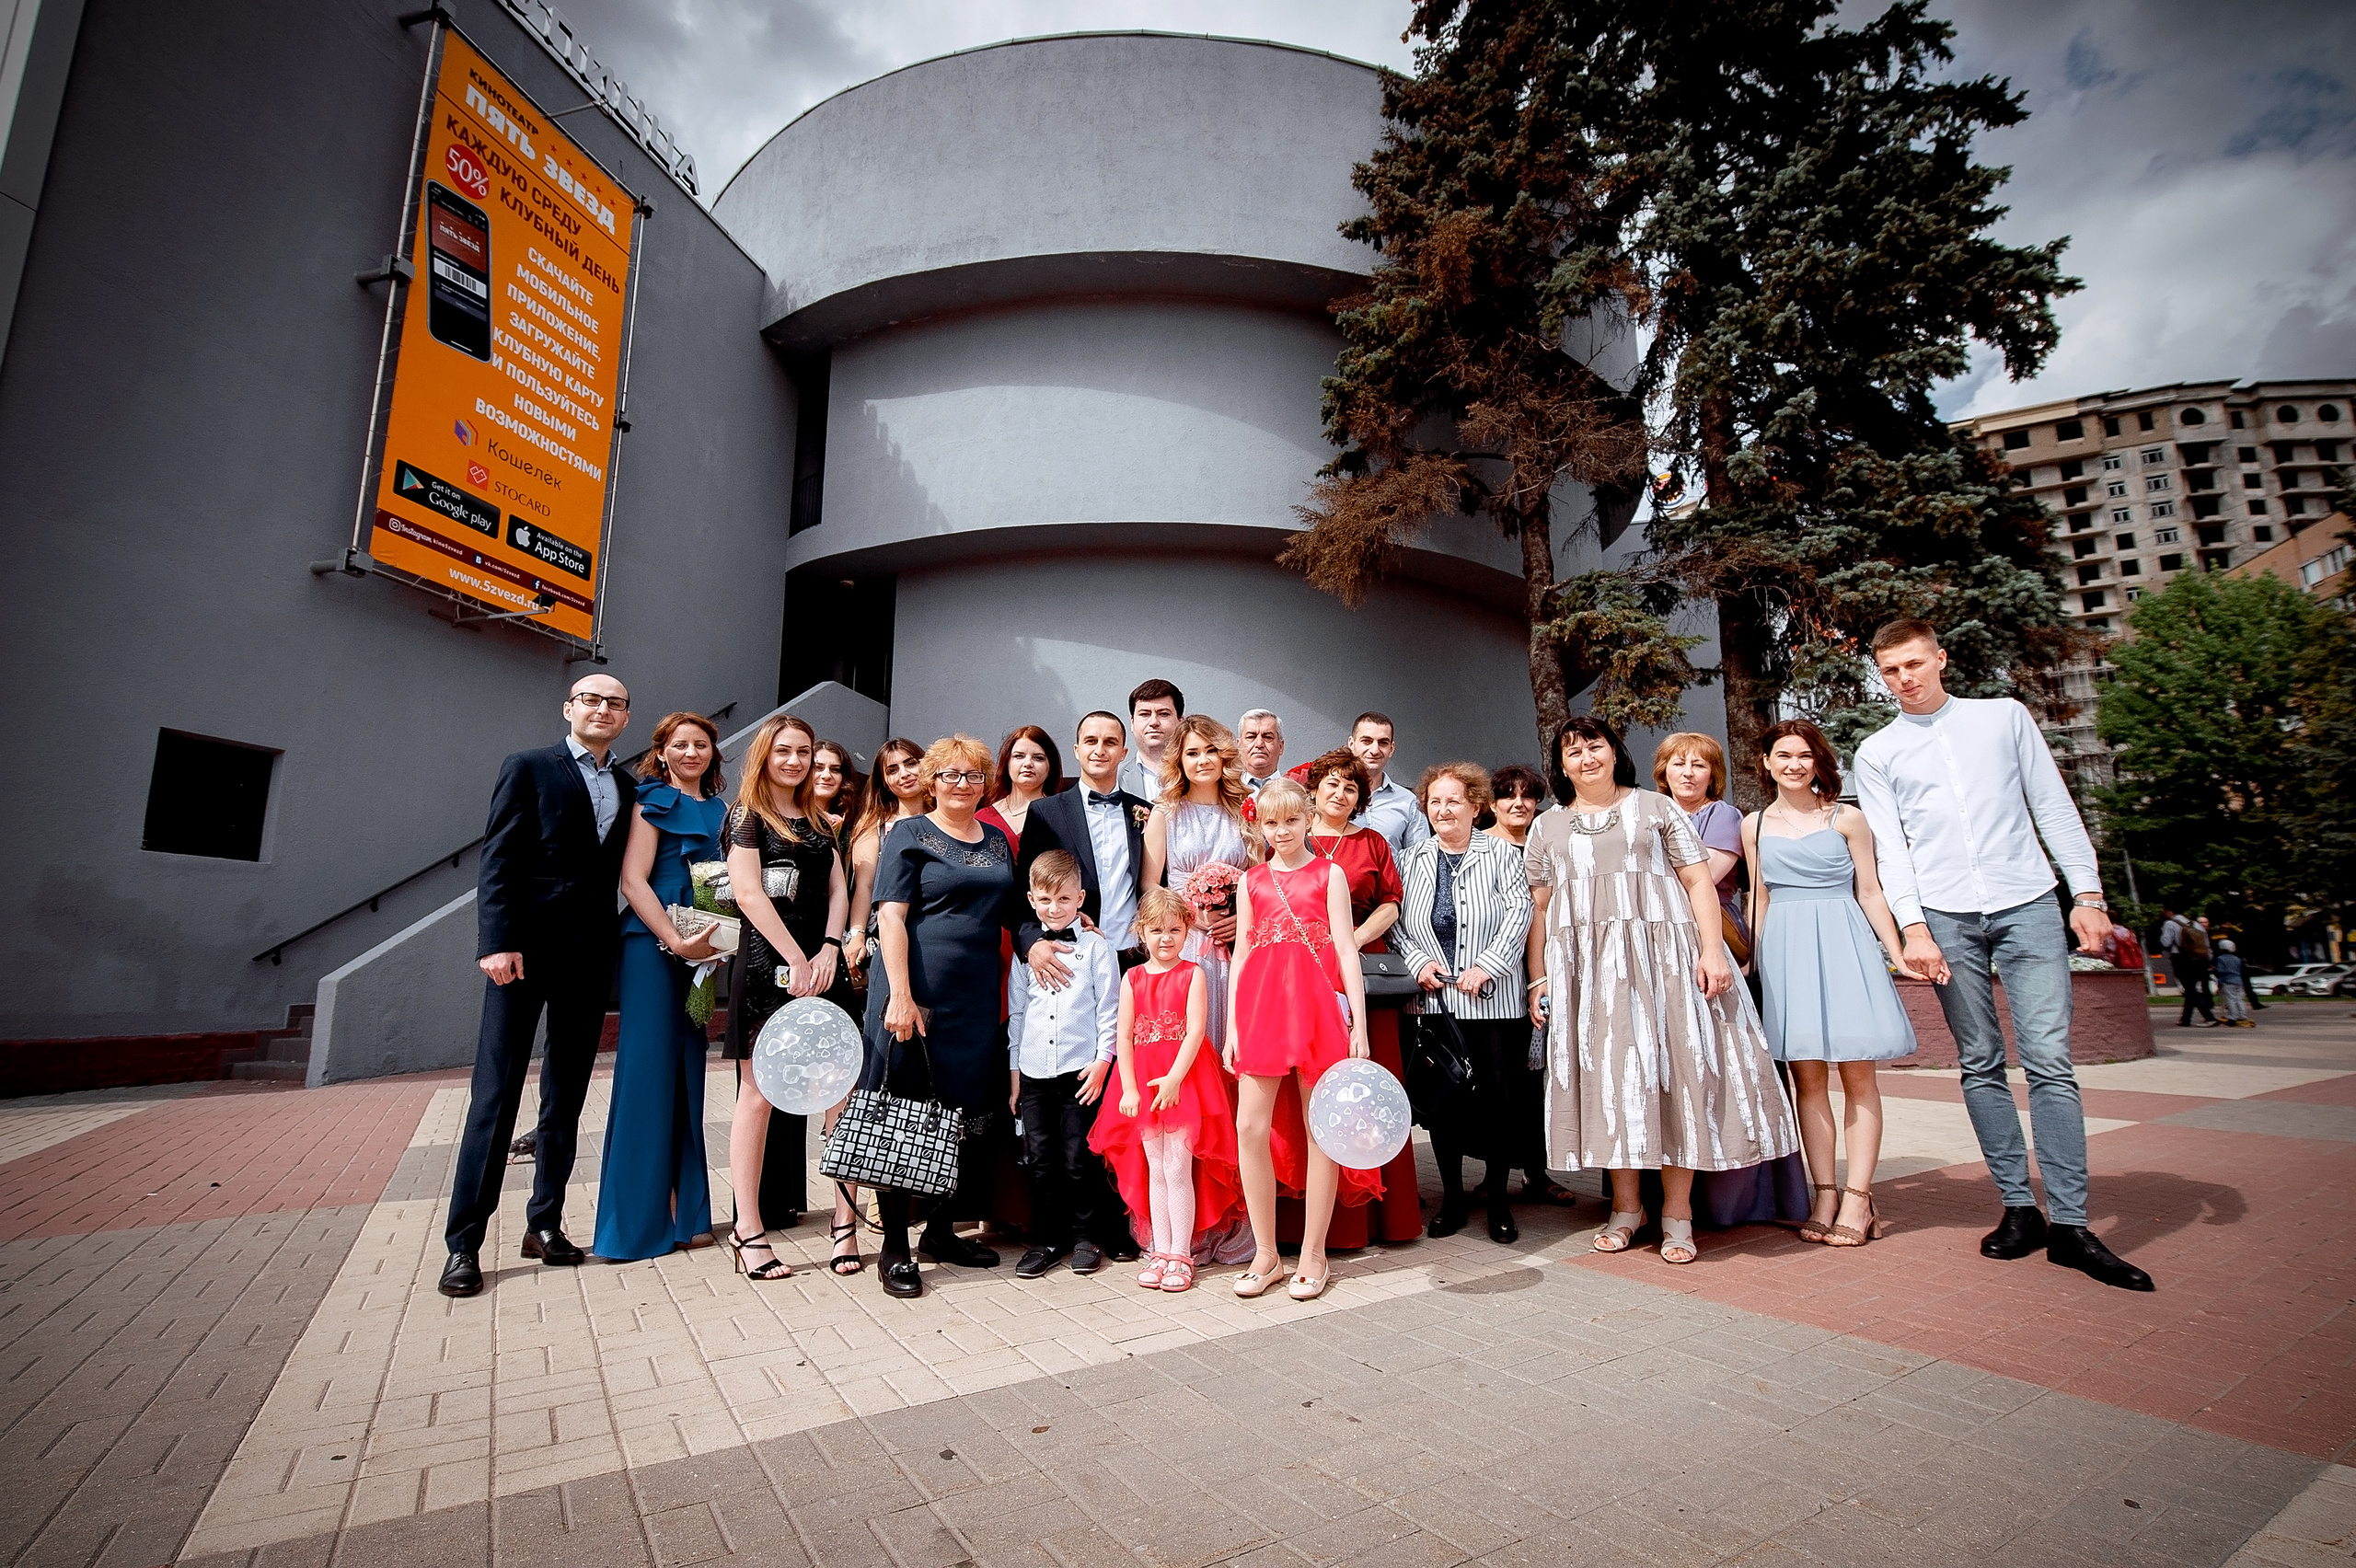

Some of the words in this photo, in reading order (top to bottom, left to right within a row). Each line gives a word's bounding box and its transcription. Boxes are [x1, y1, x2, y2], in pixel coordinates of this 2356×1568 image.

[469, 68, 538, 135] КИНОТЕАТР
[446, 147, 490, 197] 50%
[446, 113, 527, 192] КАЖДУЮ
[532, 188, 582, 236] СРЕДУ
[466, 83, 536, 161] ПЯТЬ
[543, 154, 615, 236] ЗВЕЗД
[500, 187, 580, 261] КЛУБНЫЙ
[582, 255, 620, 294] ДЕНЬ
[516, 263, 599, 334] МОБИЛЬНОЕ
[528, 247, 594, 306] СКАЧАЙТЕ
[507, 282, 601, 363] ПРИЛОЖЕНИЕ,
[509, 311, 595, 379] ЗАГРУЖАЙТЕ
[491, 352, 503, 371] И
[506, 362, 600, 432] ПОЛЬЗУЙТЕСЬ
[493, 326, 562, 382] КЛУБНУЮ
[565, 374, 605, 408] КАРТУ
[475, 397, 602, 482] ВОЗМОЖНОСТЯМИ
[514, 393, 577, 442] НОВЫМИ
[432, 481, 445, 491] Get
[445, 486, 451, 495] it
[453, 491, 461, 501] on
[488, 438, 562, 490] Кошелёк
[429, 491, 468, 518] Google
[470, 513, 491, 531] play
[494, 480, 551, 517] STOCARD
[401, 524, 433, 543] Instagram
[535, 541, 557, 561] App
[558, 552, 584, 573] Store
[537, 532, 564, 550] Available
[573, 549, 583, 559] the
[449, 568, 539, 611] www.5zvezd.ru
